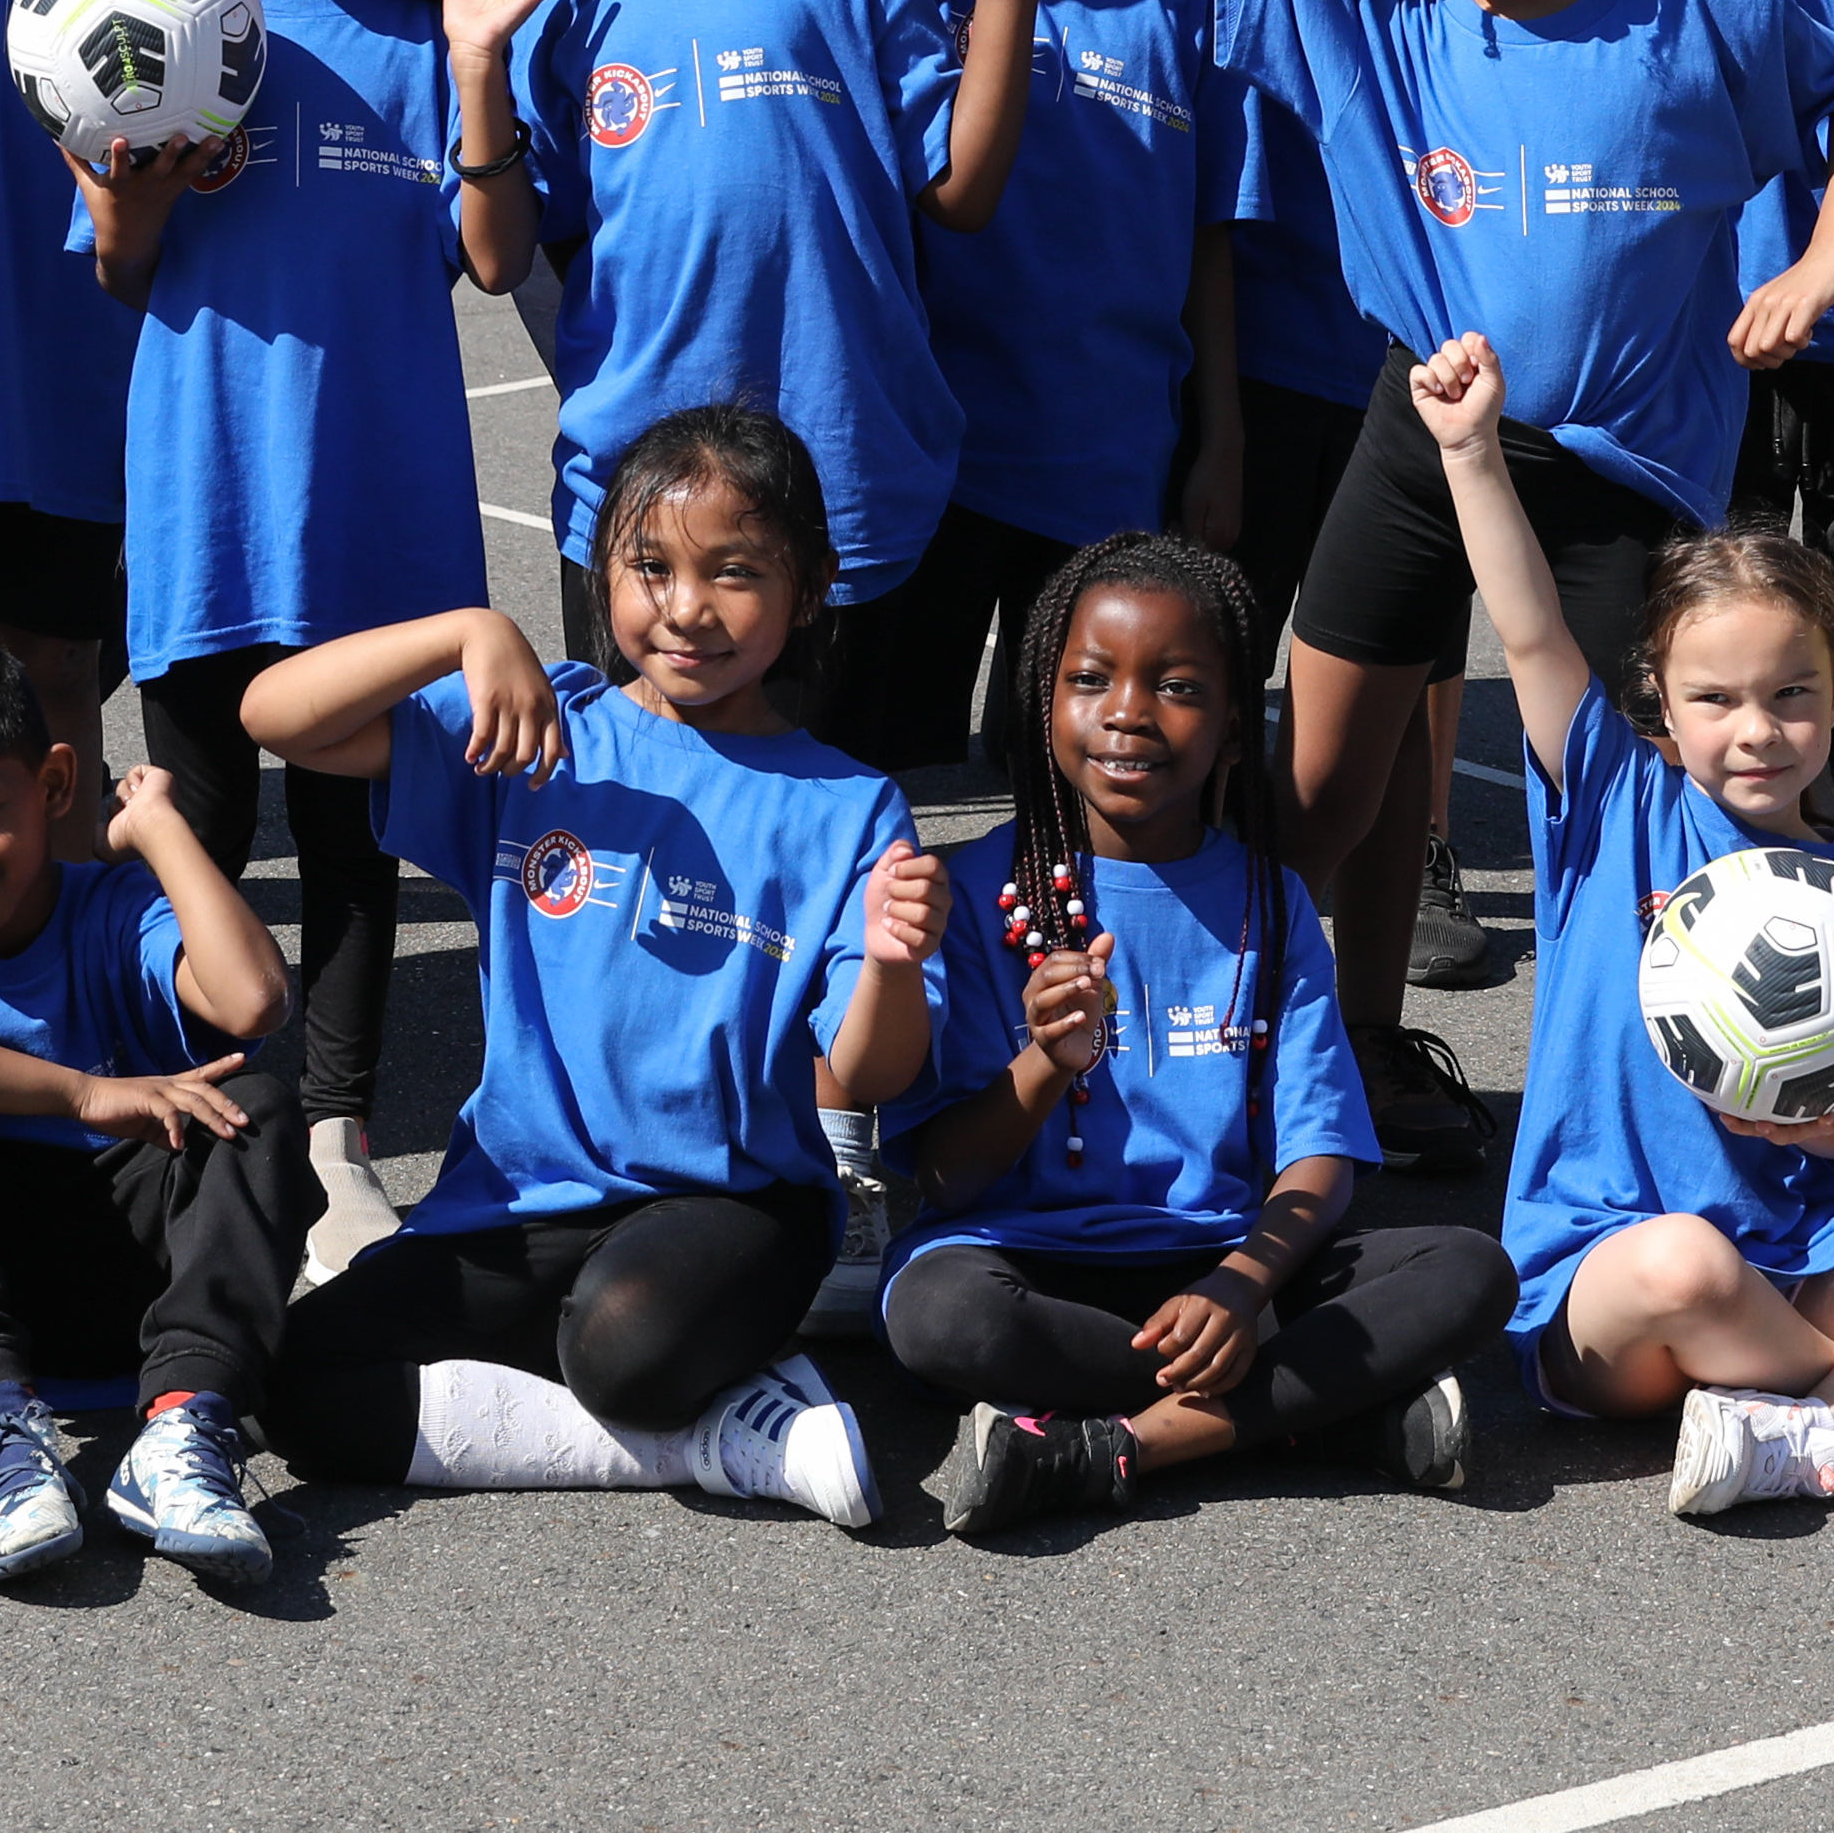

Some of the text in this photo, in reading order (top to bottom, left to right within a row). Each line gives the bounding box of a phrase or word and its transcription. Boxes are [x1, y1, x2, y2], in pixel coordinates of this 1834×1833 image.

[742, 47, 764, 55] YOUTH
[743, 53, 764, 61] SPORT
[1105, 56, 1125, 66] YOUTH
[744, 59, 764, 68] TRUST
[1104, 62, 1124, 72] SPORT
[745, 71, 806, 84] NATIONAL
[1103, 67, 1123, 78] TRUST
[746, 84, 794, 99] SPORTS
[820, 91, 842, 105] 2024
[586, 69, 649, 136] MONSTER KICKABOUT
[1099, 79, 1192, 121] NATIONAL SCHOOL
[1097, 90, 1191, 133] SPORTS WEEK 2024
[345, 135, 365, 143] TRUST
[231, 128, 244, 170] ABOUT
[344, 147, 443, 172] NATIONAL SCHOO
[1571, 163, 1593, 171] YOUTH
[344, 160, 441, 185] SPORTS WEEK 202
[1571, 169, 1593, 177] SPORT
[1571, 175, 1593, 183] TRUST
[1572, 187, 1680, 200] NATIONAL SCHOOL
[1572, 200, 1681, 213] SPORTS WEEK 2024
[527, 835, 588, 905] MONSTER KICKABOUT
[695, 880, 717, 890] YOUTH
[695, 886, 716, 896] SPORT
[693, 893, 715, 903] TRUST
[689, 904, 797, 951] NATIONAL SCHOOL
[687, 918, 792, 962] SPORTS WEEK 2024
[1193, 1005, 1214, 1013] YOUTH
[1194, 1011, 1214, 1020] SPORT
[1194, 1017, 1214, 1026] TRUST
